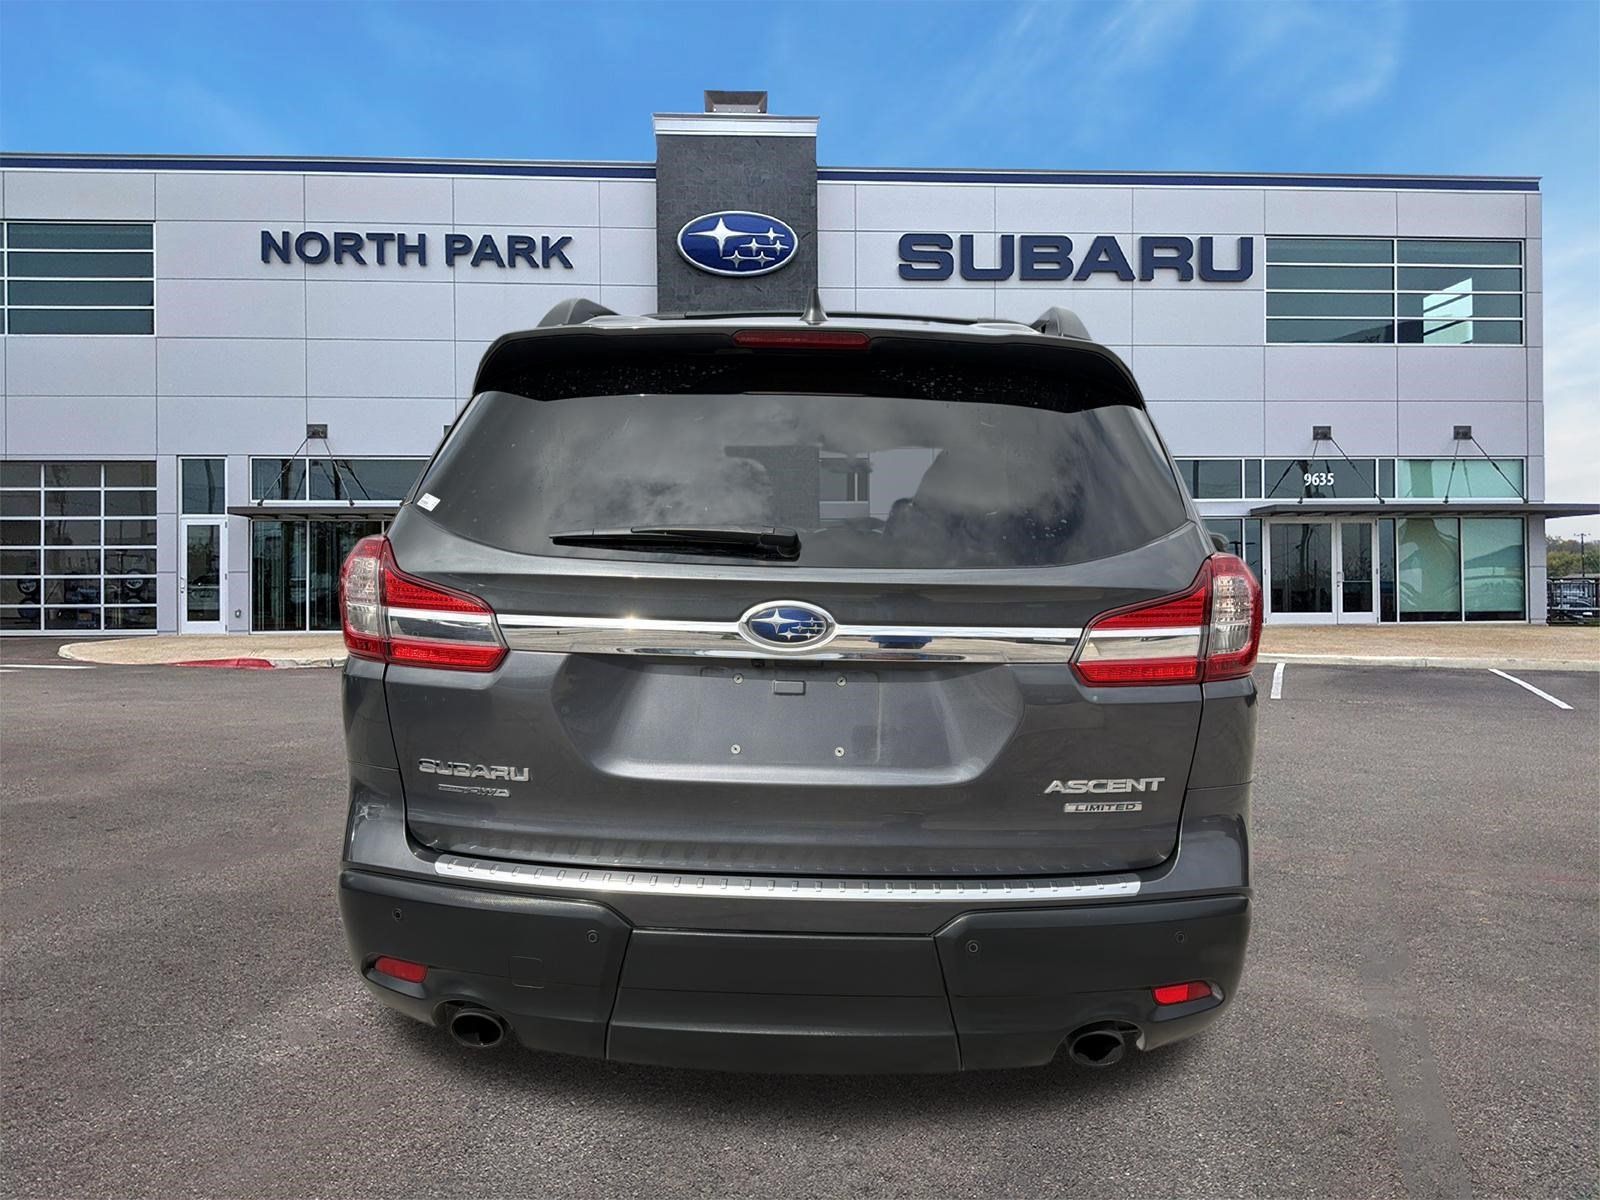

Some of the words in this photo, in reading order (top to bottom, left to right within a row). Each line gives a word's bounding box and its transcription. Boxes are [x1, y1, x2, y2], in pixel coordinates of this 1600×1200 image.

[261, 230, 428, 266] NORTH
[445, 233, 575, 270] PARK
[898, 233, 1255, 283] SUBARU
[1303, 472, 1335, 487] 9635
[418, 757, 530, 782] SUBARU
[1043, 777, 1166, 794] ASCENT
[1075, 803, 1136, 812] LIMITED
